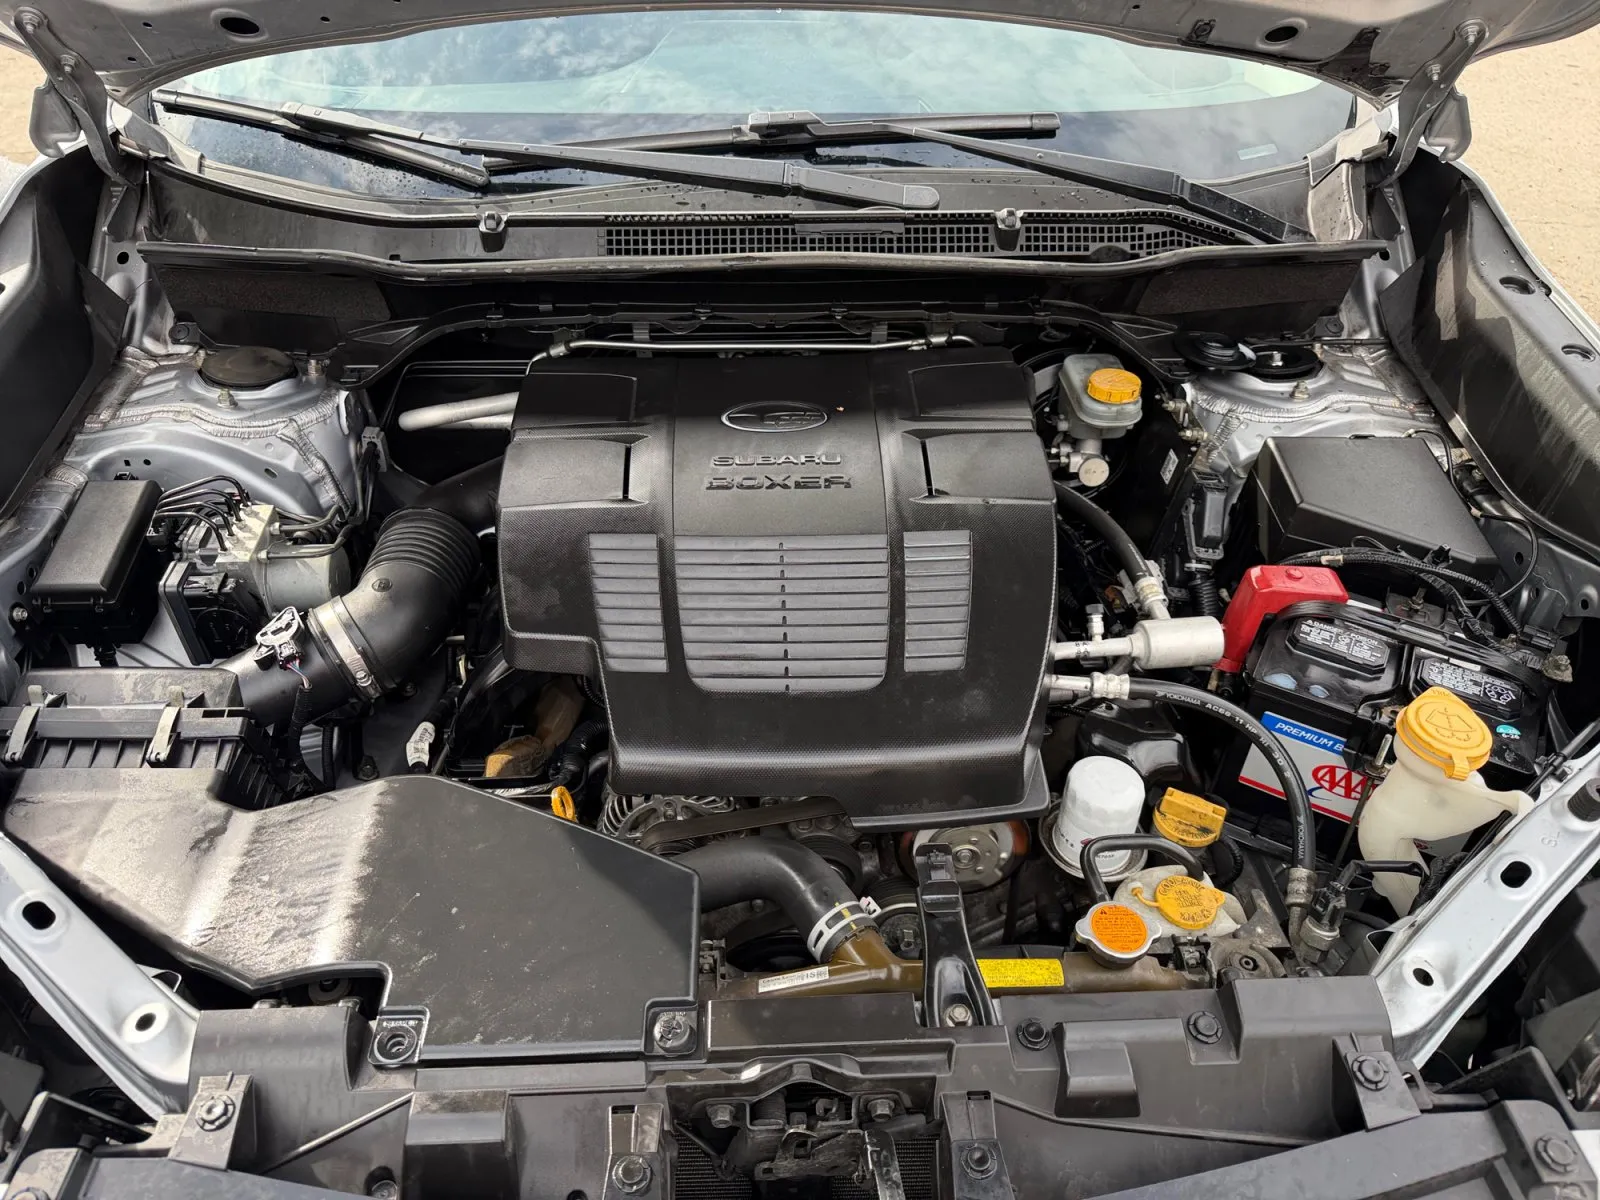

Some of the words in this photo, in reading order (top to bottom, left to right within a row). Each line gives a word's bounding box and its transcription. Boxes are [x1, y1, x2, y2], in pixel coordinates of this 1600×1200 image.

[712, 453, 842, 466] SUBARU
[705, 475, 852, 490] BOXER
[1275, 722, 1334, 747] PREMIUM
